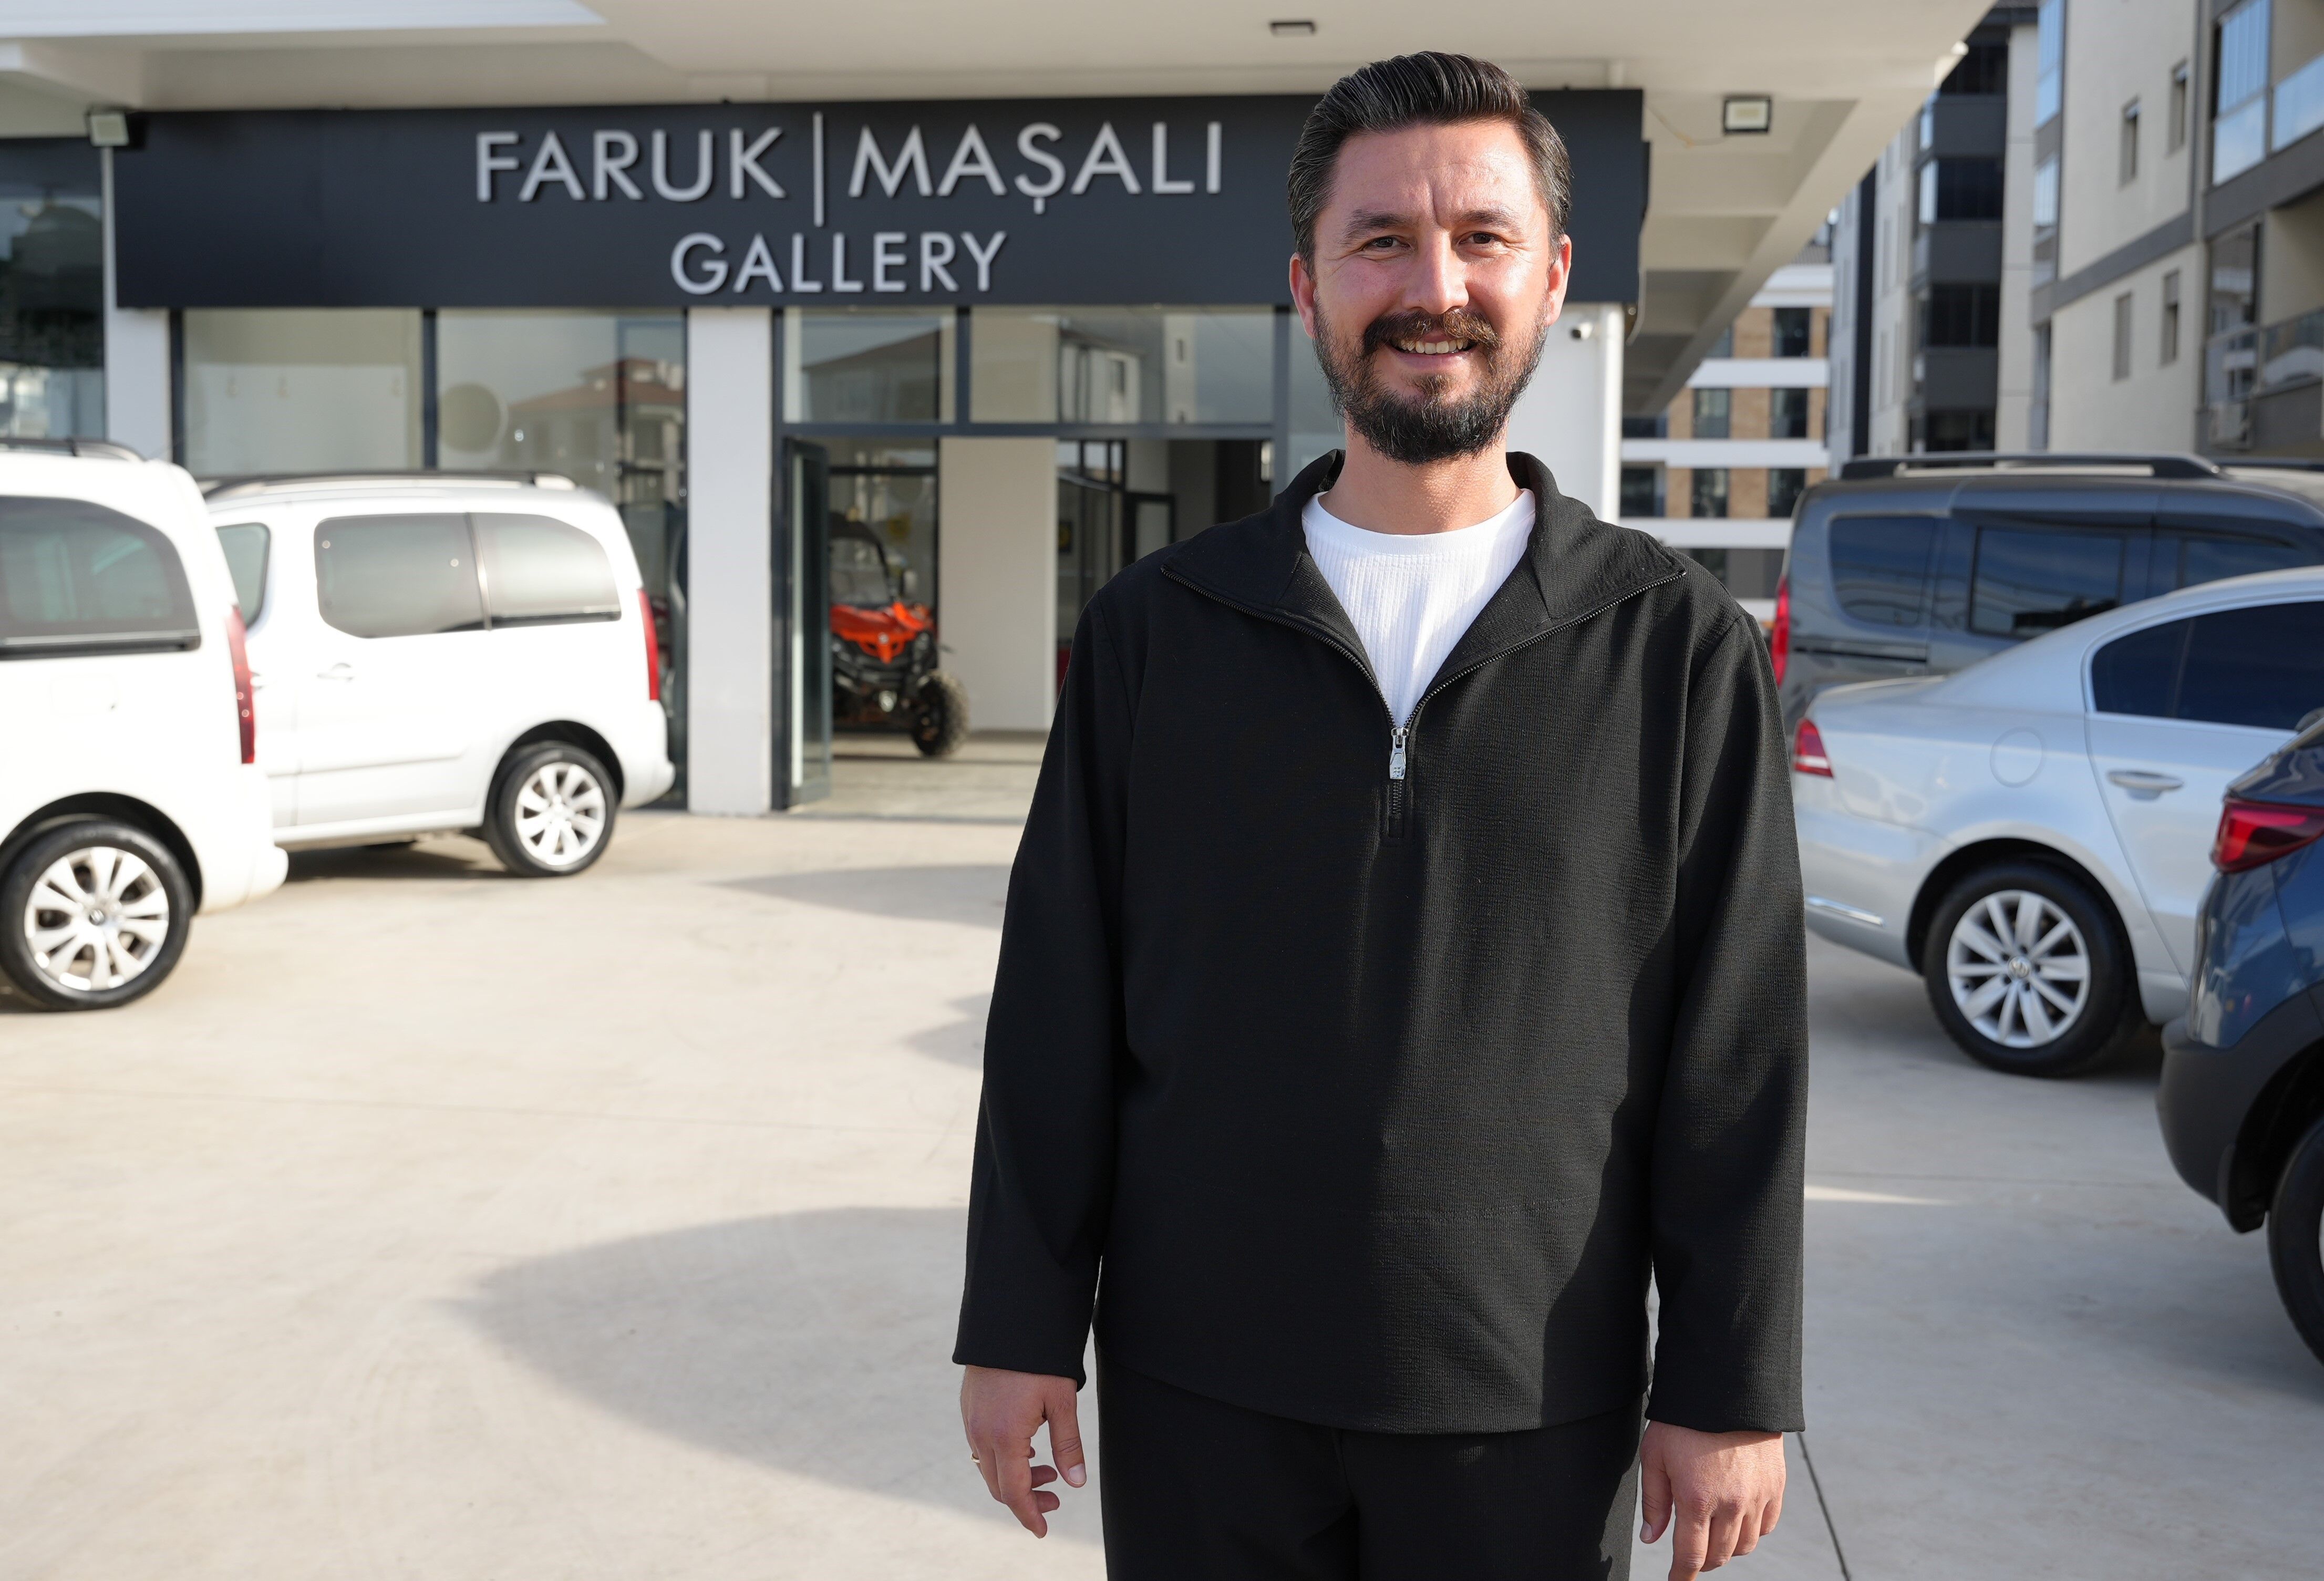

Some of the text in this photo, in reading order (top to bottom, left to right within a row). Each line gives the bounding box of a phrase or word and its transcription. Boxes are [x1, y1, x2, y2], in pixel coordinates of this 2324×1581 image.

[477, 122, 1221, 214] FARUK MAŞALI
[670, 231, 1006, 295] GALLERY
